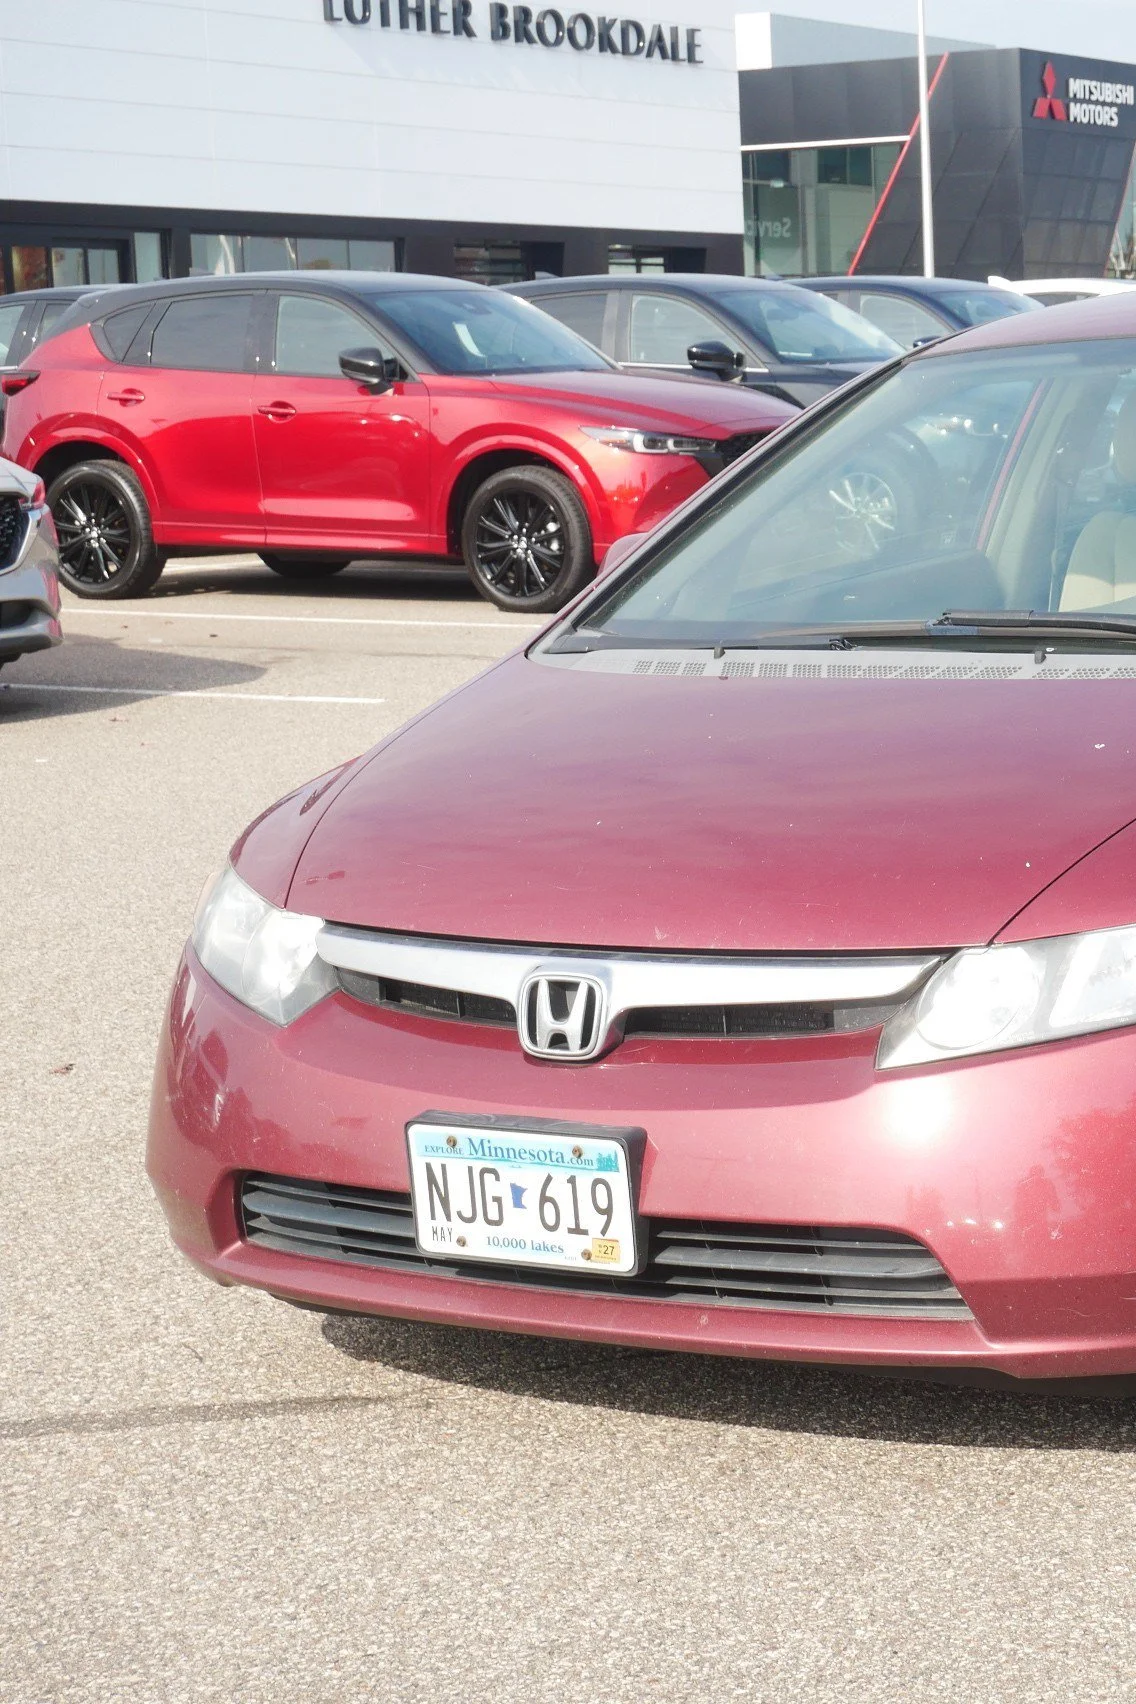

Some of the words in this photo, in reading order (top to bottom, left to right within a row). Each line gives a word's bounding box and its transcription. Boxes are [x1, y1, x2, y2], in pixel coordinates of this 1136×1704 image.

[489, 2, 704, 64] BROOKDALE
[1068, 77, 1134, 106] MITSUBISHI
[1069, 101, 1119, 128] MOTORS
[424, 1144, 464, 1156] EXPLORE
[424, 1161, 504, 1227] NJG
[538, 1172, 615, 1238] 619
[431, 1225, 453, 1243] MAY
[486, 1235, 527, 1251] 10,000
[530, 1239, 565, 1254] lakes
[603, 1244, 615, 1256] 27
